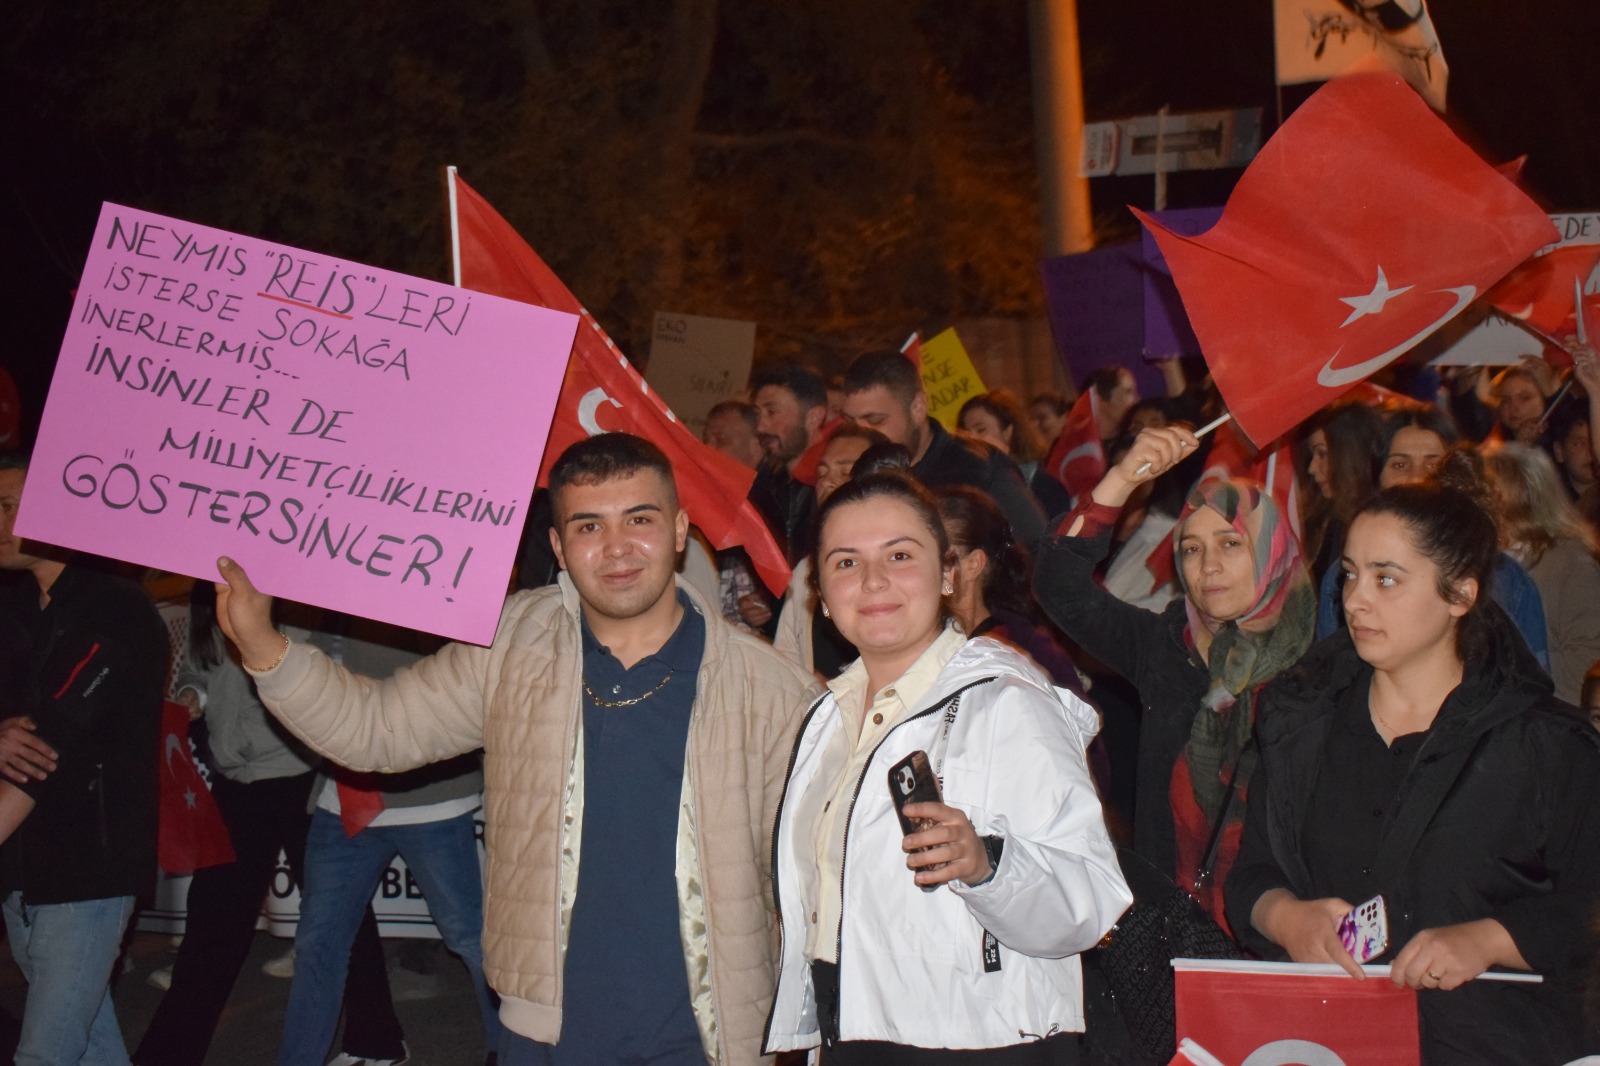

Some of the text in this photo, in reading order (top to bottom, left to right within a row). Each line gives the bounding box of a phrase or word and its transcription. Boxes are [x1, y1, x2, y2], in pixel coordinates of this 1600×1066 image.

[103, 262, 411, 381] İSTERSE SOKAĞA
[85, 335, 355, 443] İNSİNLER DE
